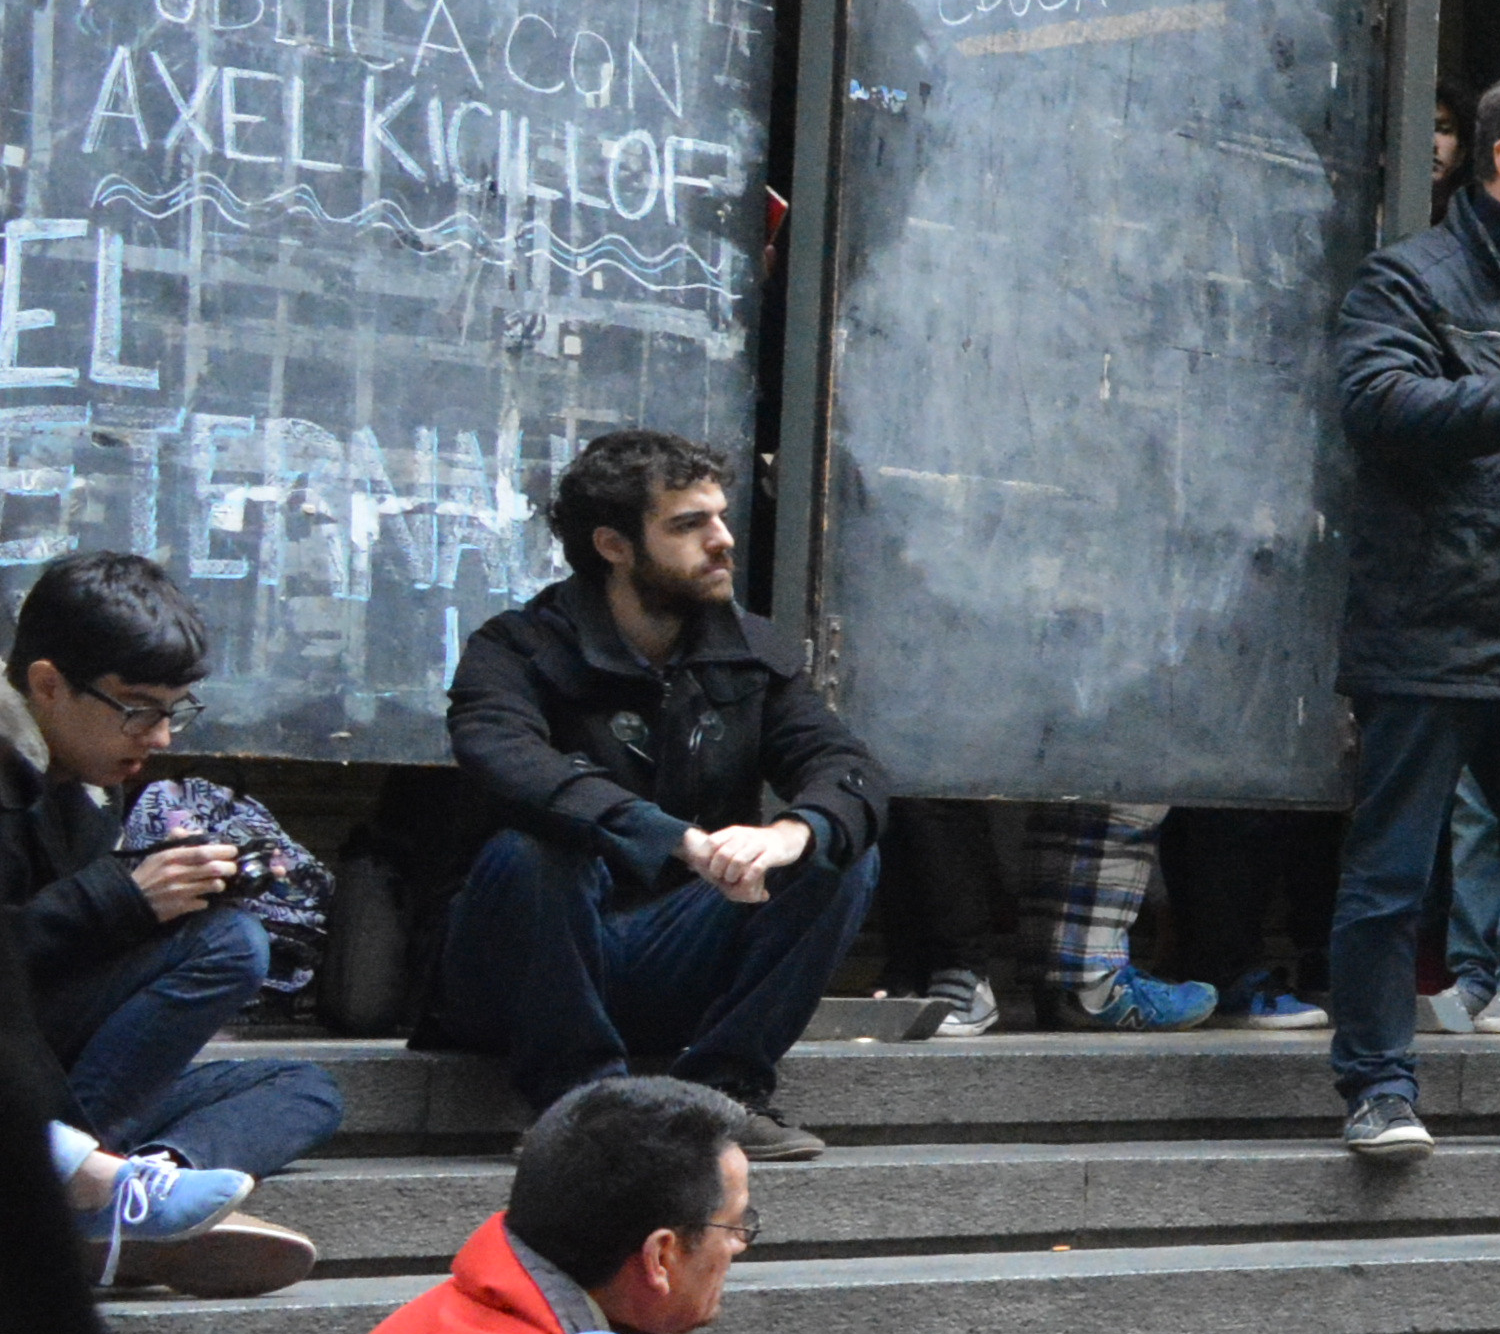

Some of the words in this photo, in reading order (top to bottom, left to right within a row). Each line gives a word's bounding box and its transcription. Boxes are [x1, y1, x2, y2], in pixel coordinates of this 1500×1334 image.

[82, 44, 343, 171] AXEL
[505, 14, 683, 119] CON
[0, 217, 161, 391] EL
